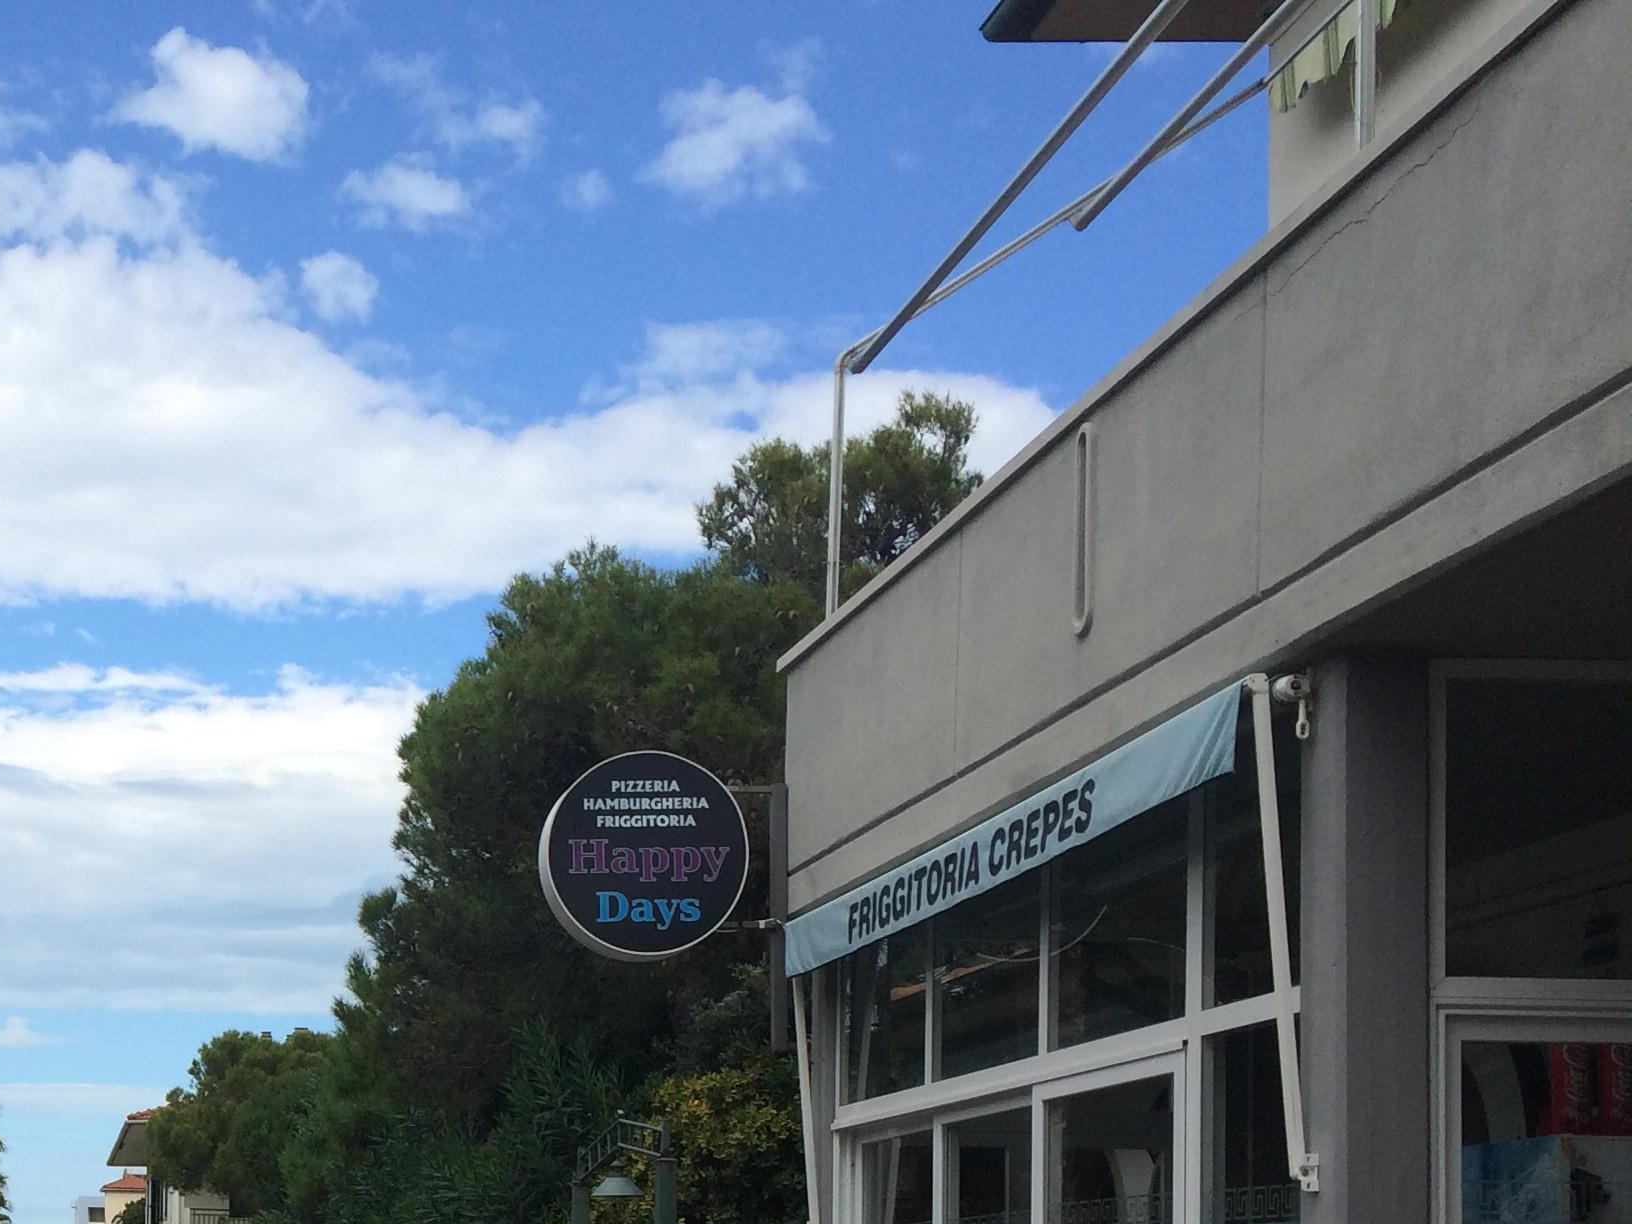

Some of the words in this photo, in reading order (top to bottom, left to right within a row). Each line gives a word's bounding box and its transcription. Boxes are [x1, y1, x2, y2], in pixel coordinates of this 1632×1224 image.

[611, 780, 680, 793] PIZZERIA
[583, 797, 709, 811] HAMBURGHERIA
[596, 814, 696, 828] FRIGGITORIA
[568, 839, 730, 882] Happy
[848, 843, 980, 944] FRIGGITORIA
[988, 779, 1095, 877] CREPES
[595, 891, 701, 930] Days
